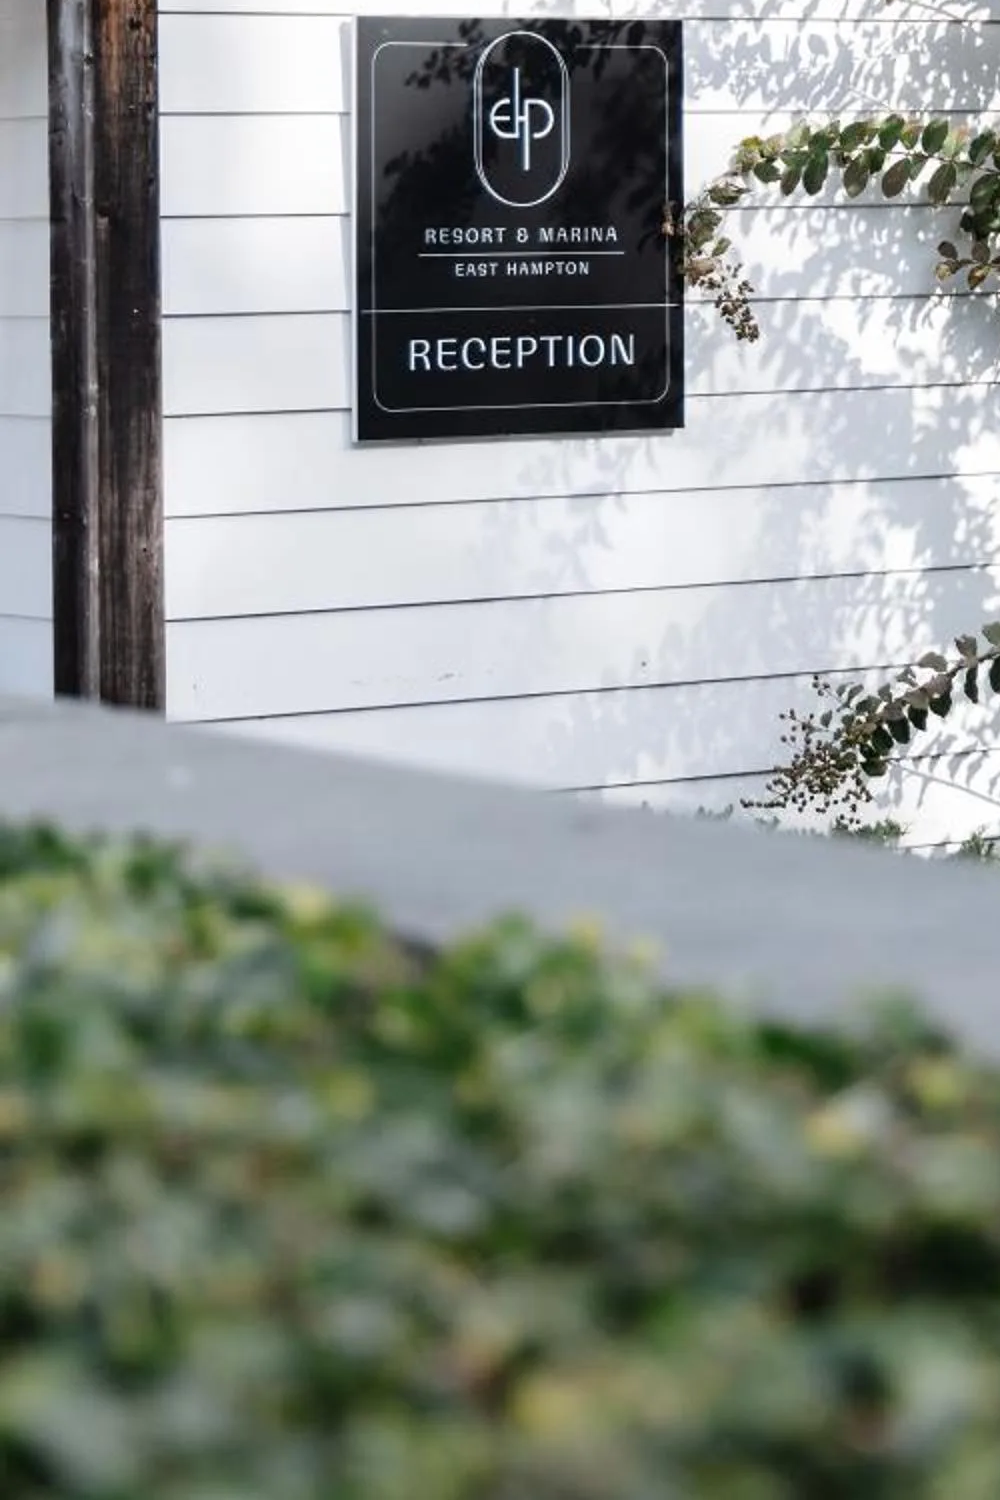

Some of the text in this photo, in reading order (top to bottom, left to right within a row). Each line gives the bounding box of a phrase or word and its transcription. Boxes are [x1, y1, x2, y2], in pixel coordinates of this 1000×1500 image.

[424, 226, 619, 244] RESORT & MARINA
[455, 261, 590, 277] EAST HAMPTON
[408, 333, 636, 371] RECEPTION
